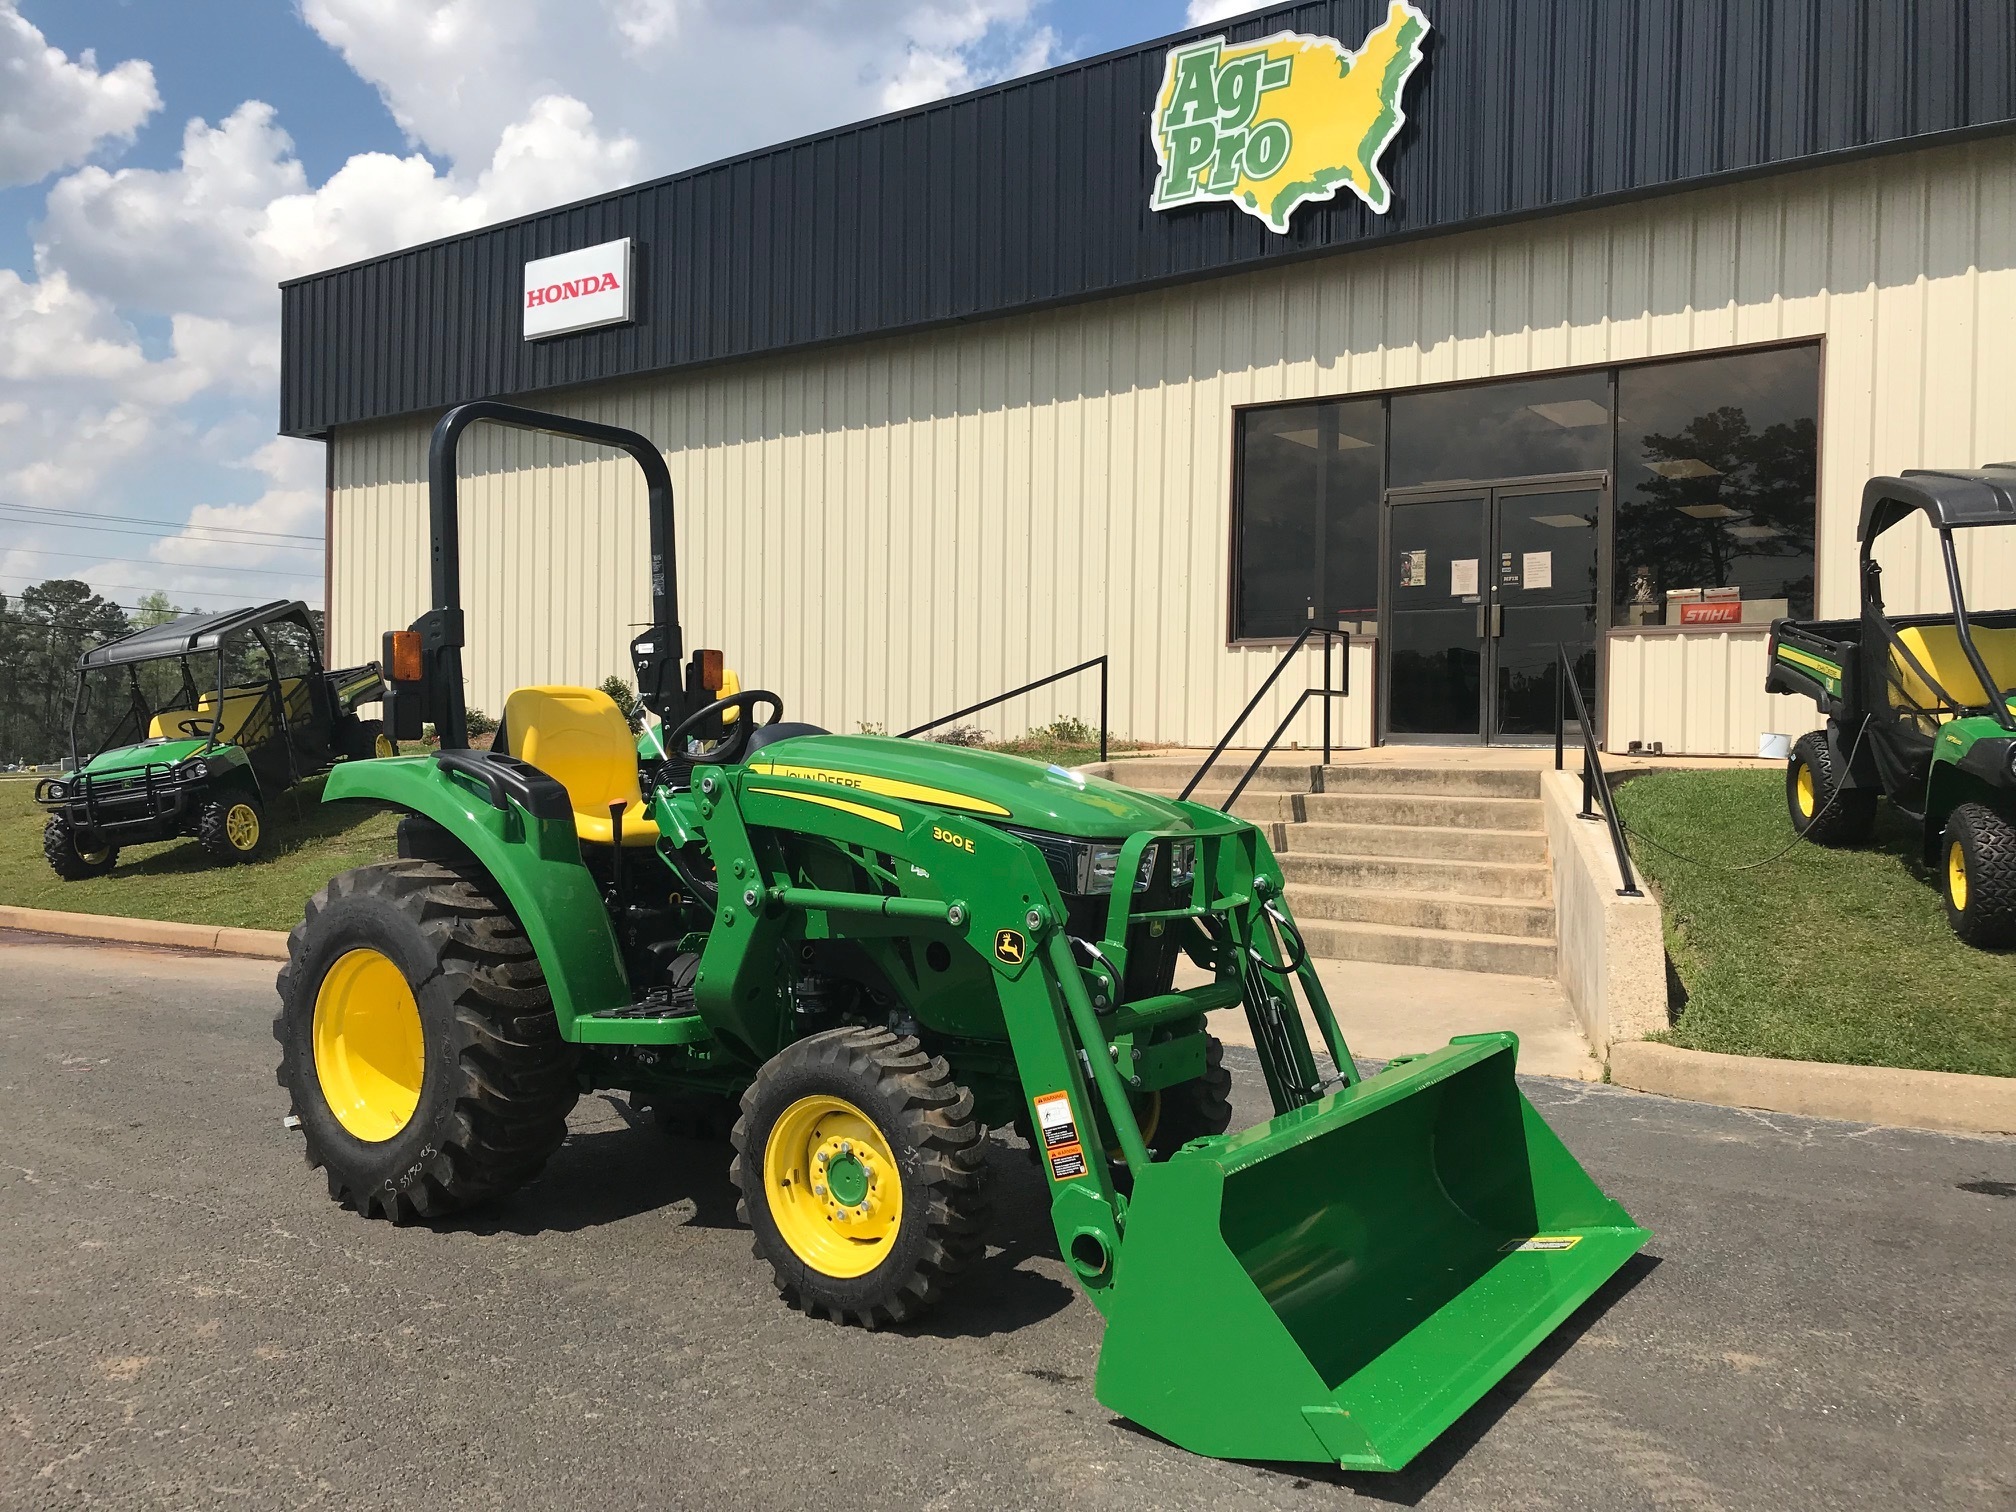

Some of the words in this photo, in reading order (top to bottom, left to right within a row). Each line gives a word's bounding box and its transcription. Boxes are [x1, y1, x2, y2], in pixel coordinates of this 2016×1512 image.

[1160, 43, 1293, 134] Ag-
[1158, 118, 1292, 203] Pro
[527, 272, 620, 308] HONDA
[1684, 608, 1734, 621] STIHL
[933, 826, 976, 854] 300E
